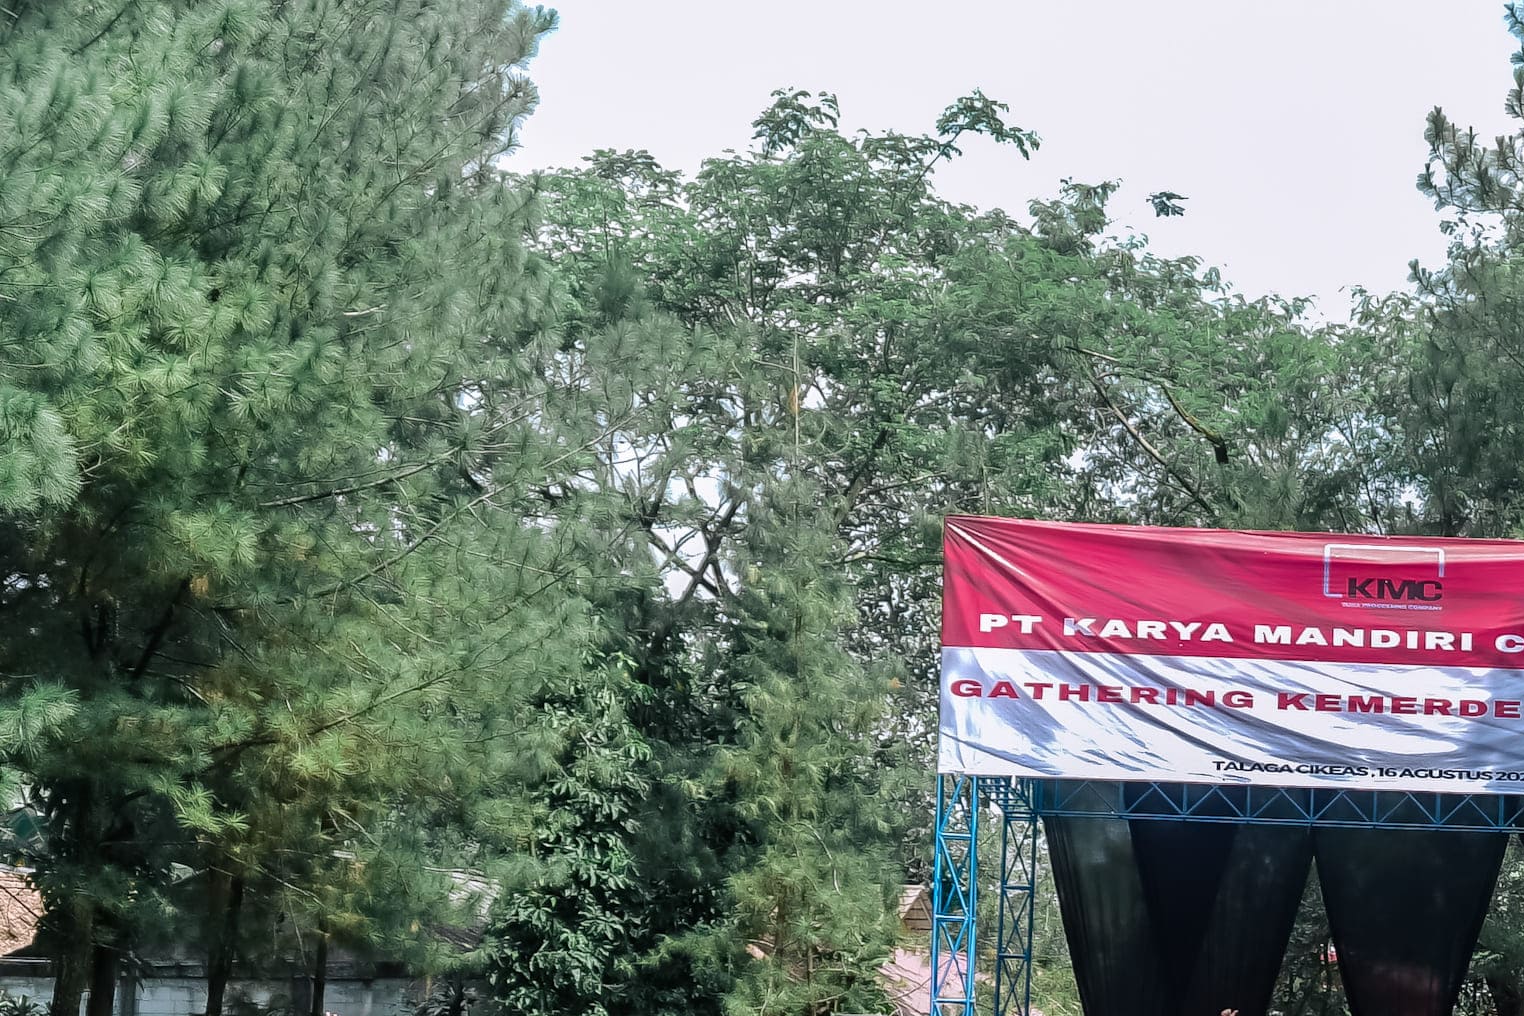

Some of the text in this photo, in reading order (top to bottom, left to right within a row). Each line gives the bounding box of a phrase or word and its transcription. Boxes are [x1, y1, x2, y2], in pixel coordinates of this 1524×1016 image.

[1348, 577, 1442, 601] KMC
[979, 613, 1042, 634] PT
[1063, 618, 1233, 643] KARYA
[1253, 624, 1473, 652] MANDIRI
[950, 680, 1255, 709] GATHERING
[1212, 761, 1293, 773] TALAGA
[1399, 768, 1493, 781] AGUSTUS
